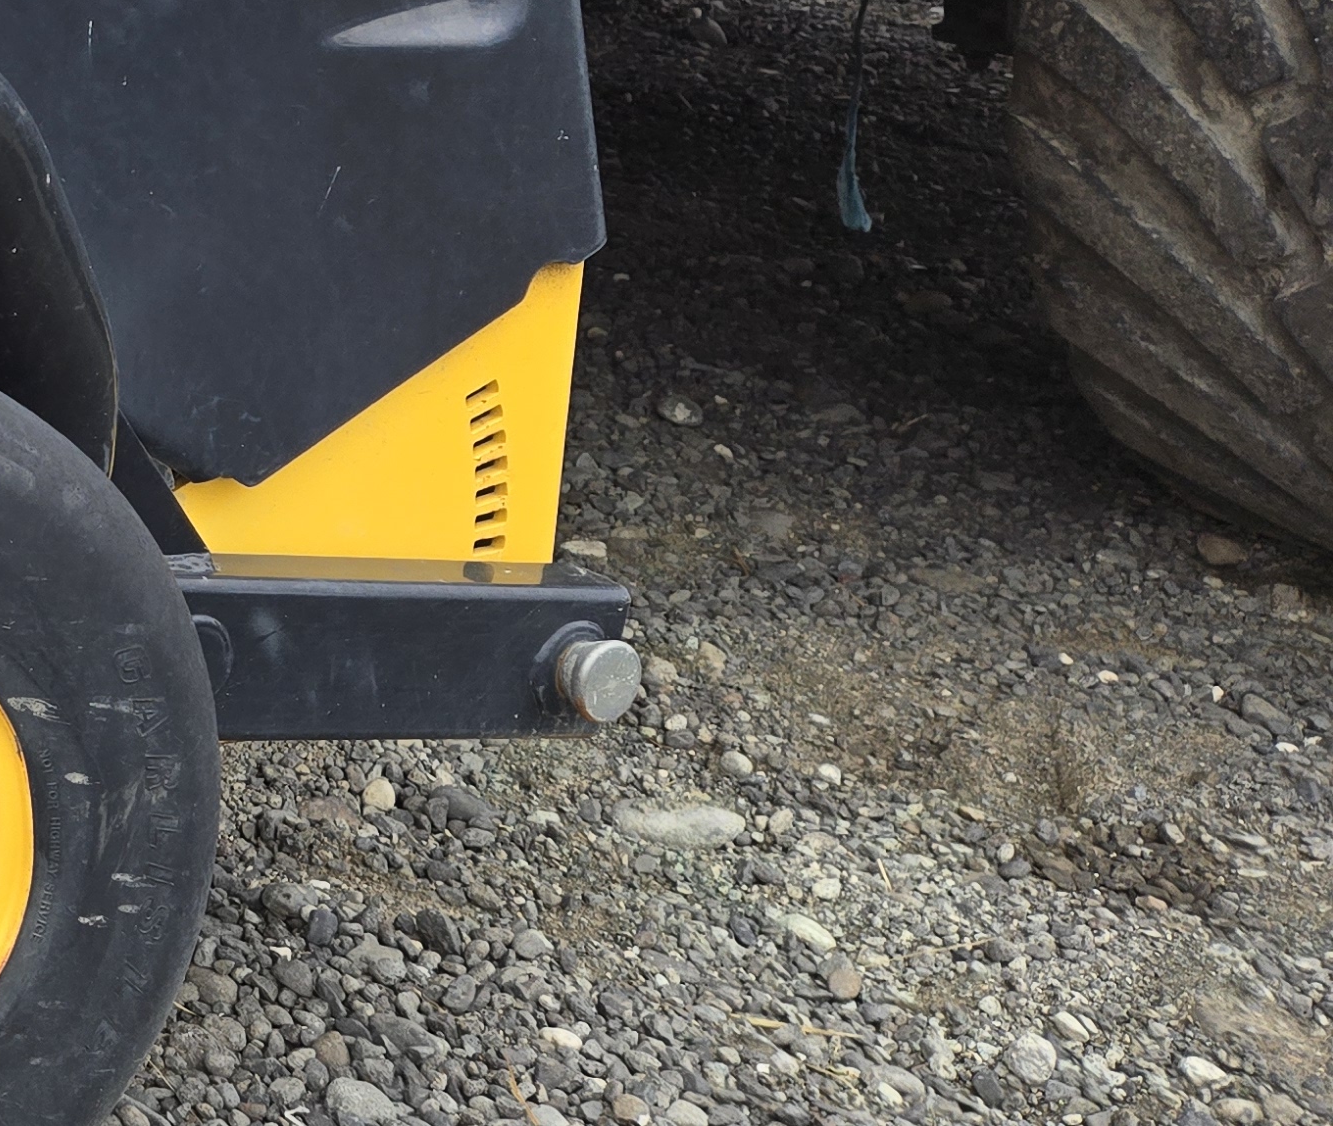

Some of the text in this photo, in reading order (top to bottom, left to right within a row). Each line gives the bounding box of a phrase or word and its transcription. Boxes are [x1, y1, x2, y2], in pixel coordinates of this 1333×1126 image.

[30, 748, 62, 945] NOT FOR HIGHWAY SERVICE
